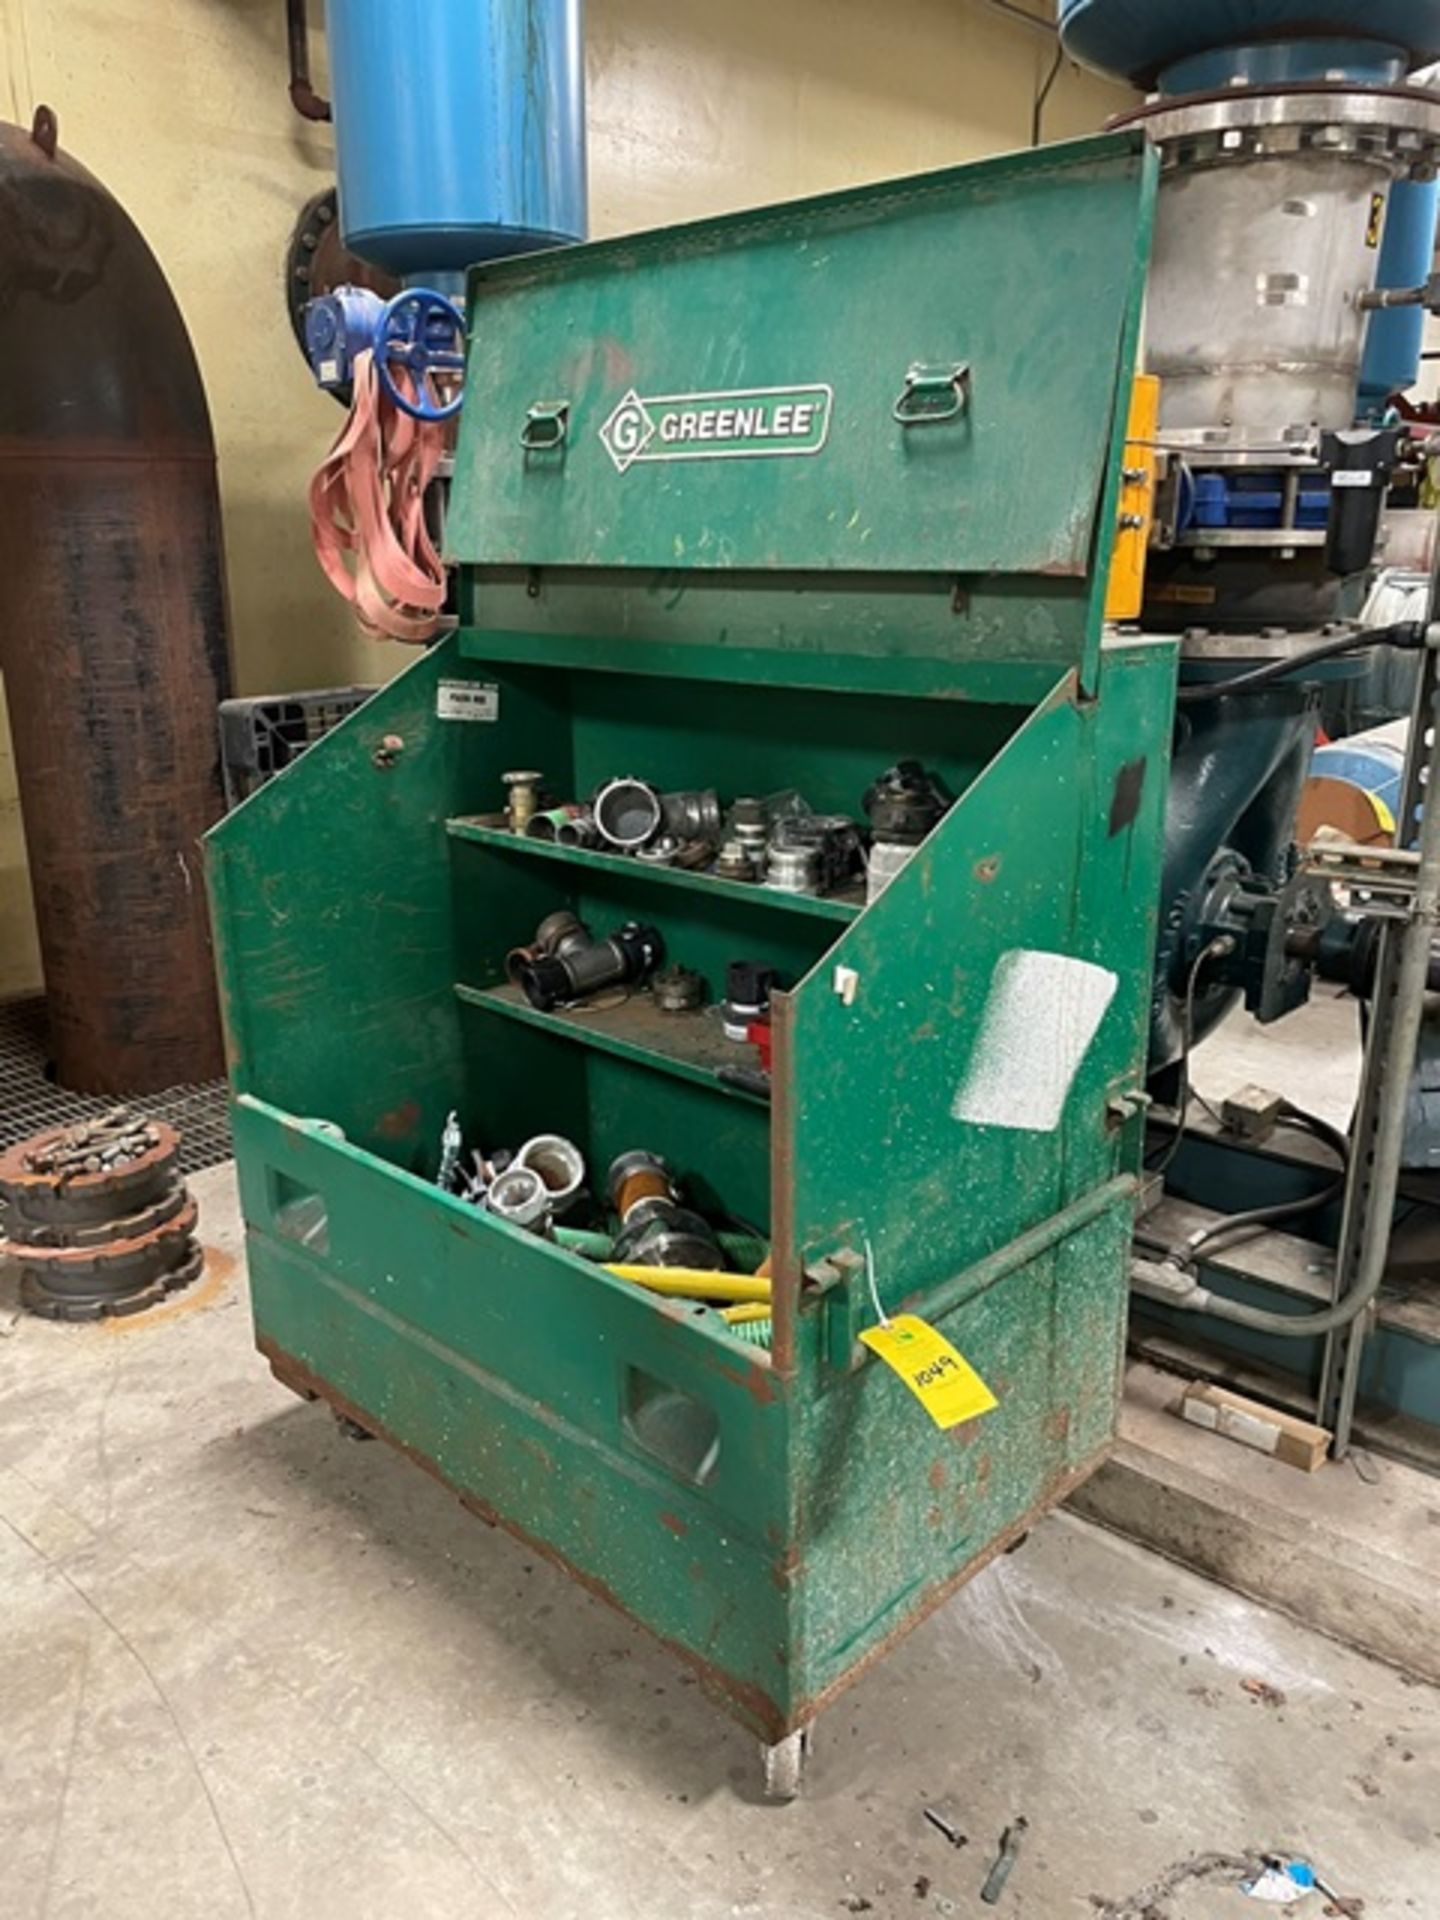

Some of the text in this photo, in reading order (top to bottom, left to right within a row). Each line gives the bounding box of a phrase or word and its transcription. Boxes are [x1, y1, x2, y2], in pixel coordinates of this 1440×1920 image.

[612, 404, 813, 450] G GREENLEE
[913, 1355, 960, 1387] 1049
